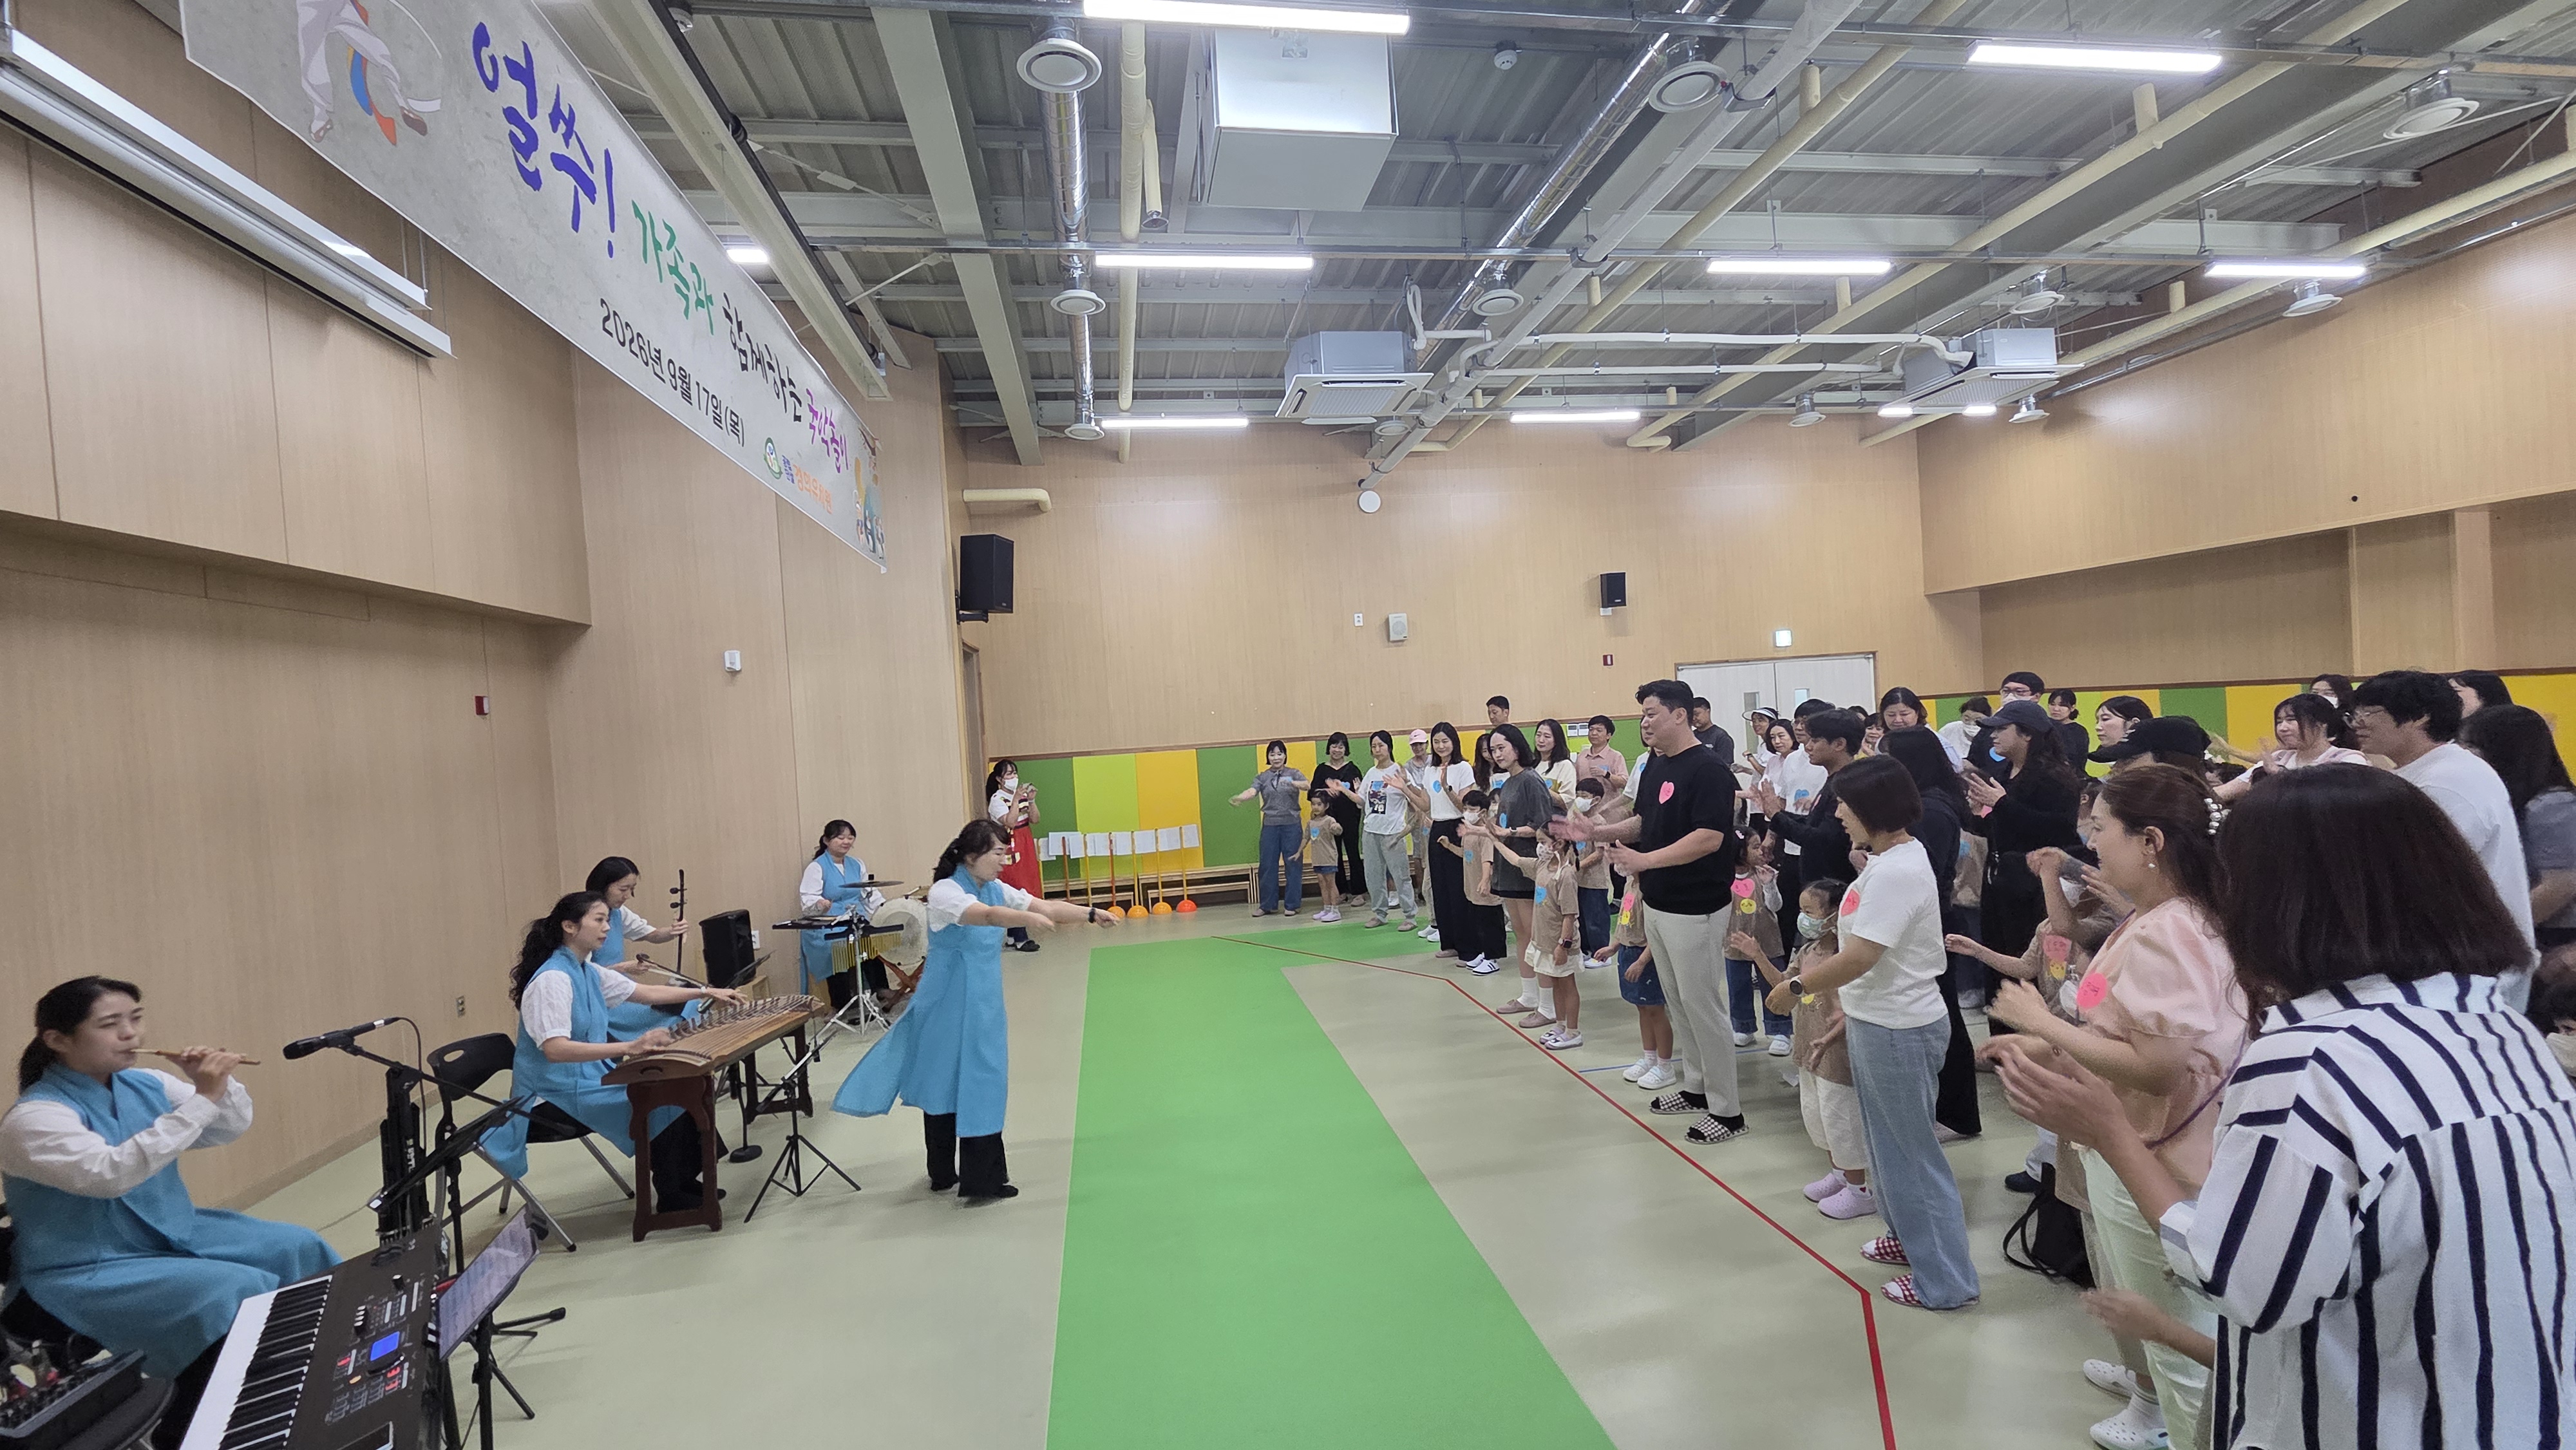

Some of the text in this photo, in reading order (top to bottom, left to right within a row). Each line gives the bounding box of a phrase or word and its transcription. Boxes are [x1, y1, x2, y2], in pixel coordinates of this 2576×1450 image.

[472, 22, 849, 473] 얼쑤! 가족과 함께하는 국악놀이
[600, 298, 744, 447] 2026년 9월 17일(목)
